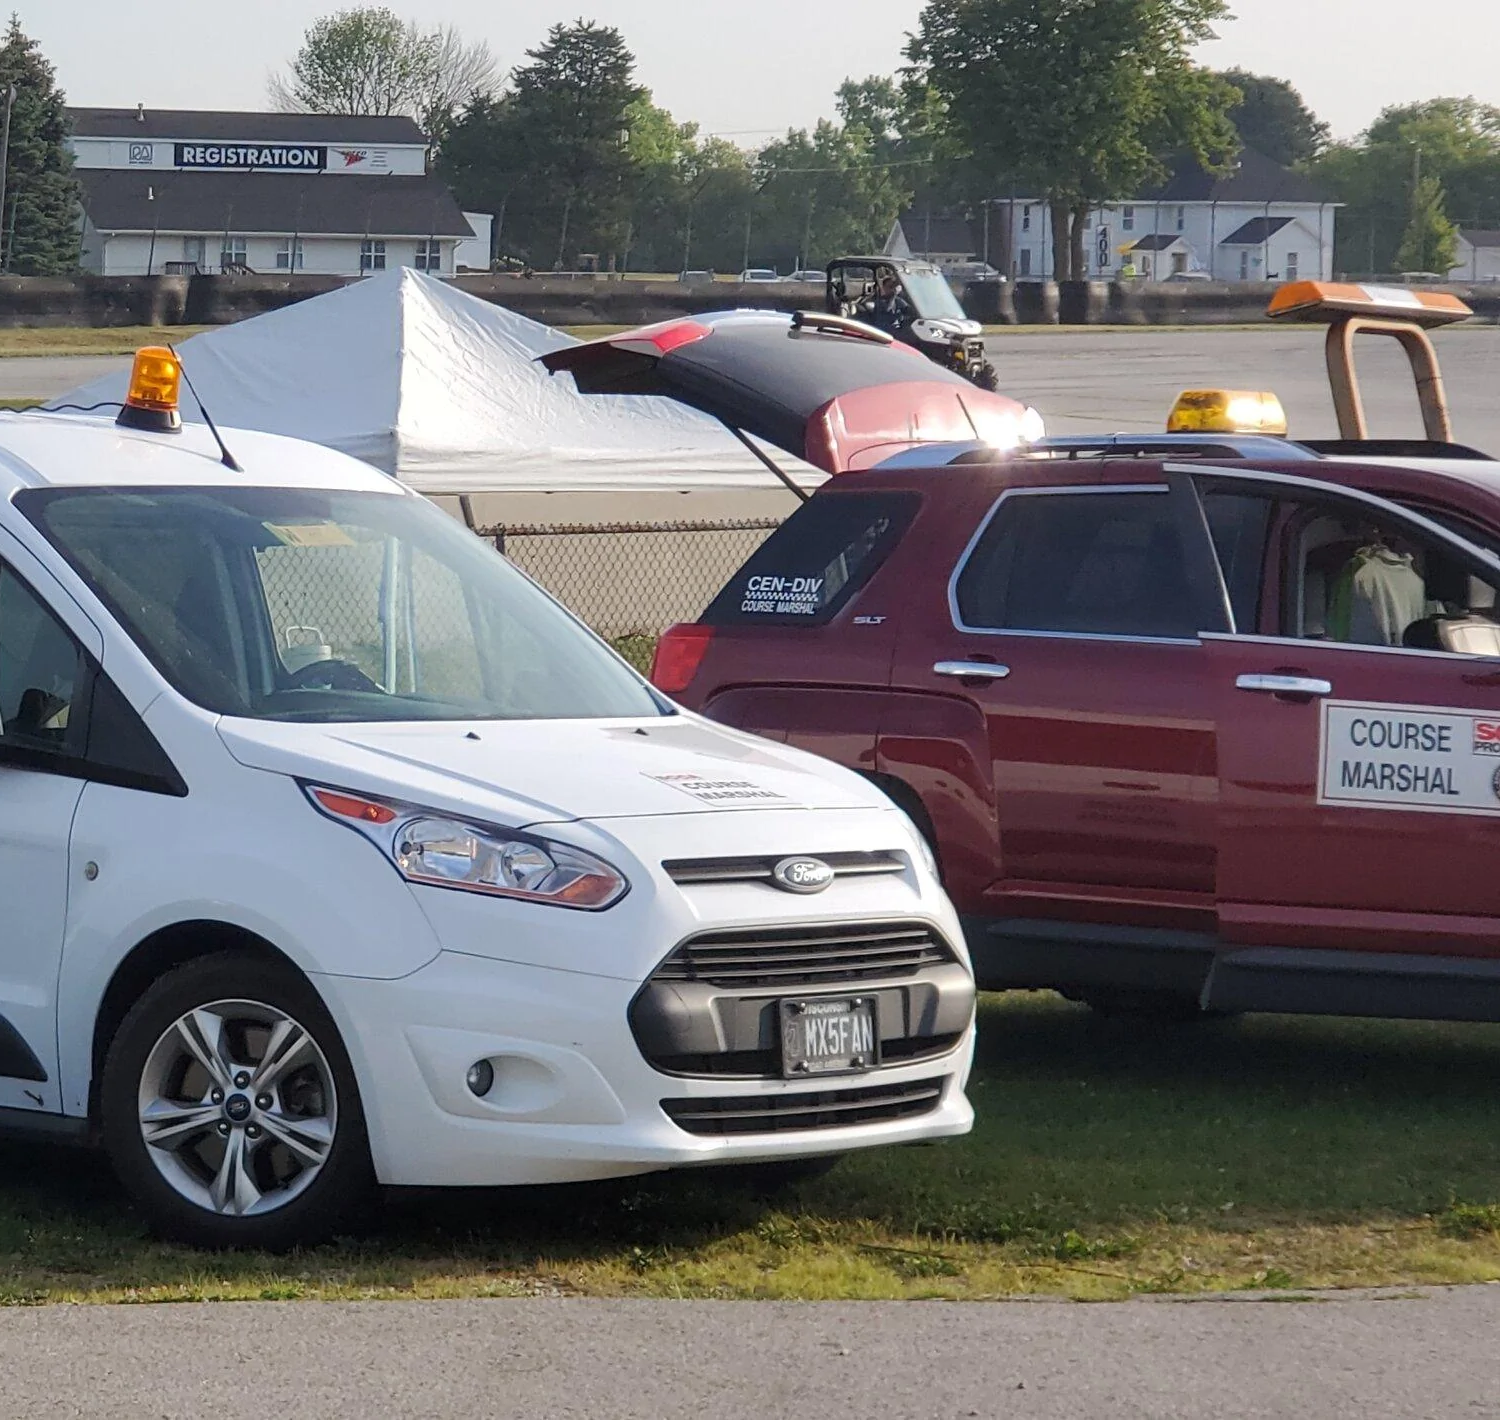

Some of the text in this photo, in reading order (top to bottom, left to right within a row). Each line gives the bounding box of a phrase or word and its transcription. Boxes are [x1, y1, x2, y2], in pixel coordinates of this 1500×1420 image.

[183, 146, 319, 165] REGISTRATION
[1099, 226, 1108, 267] 400
[748, 576, 824, 593] CEN-DIV
[741, 600, 815, 615] COURSE MARSHAL
[1350, 718, 1452, 752] COURSE
[1341, 760, 1460, 795] MARSHAL
[805, 1014, 873, 1056] MX5FAN
